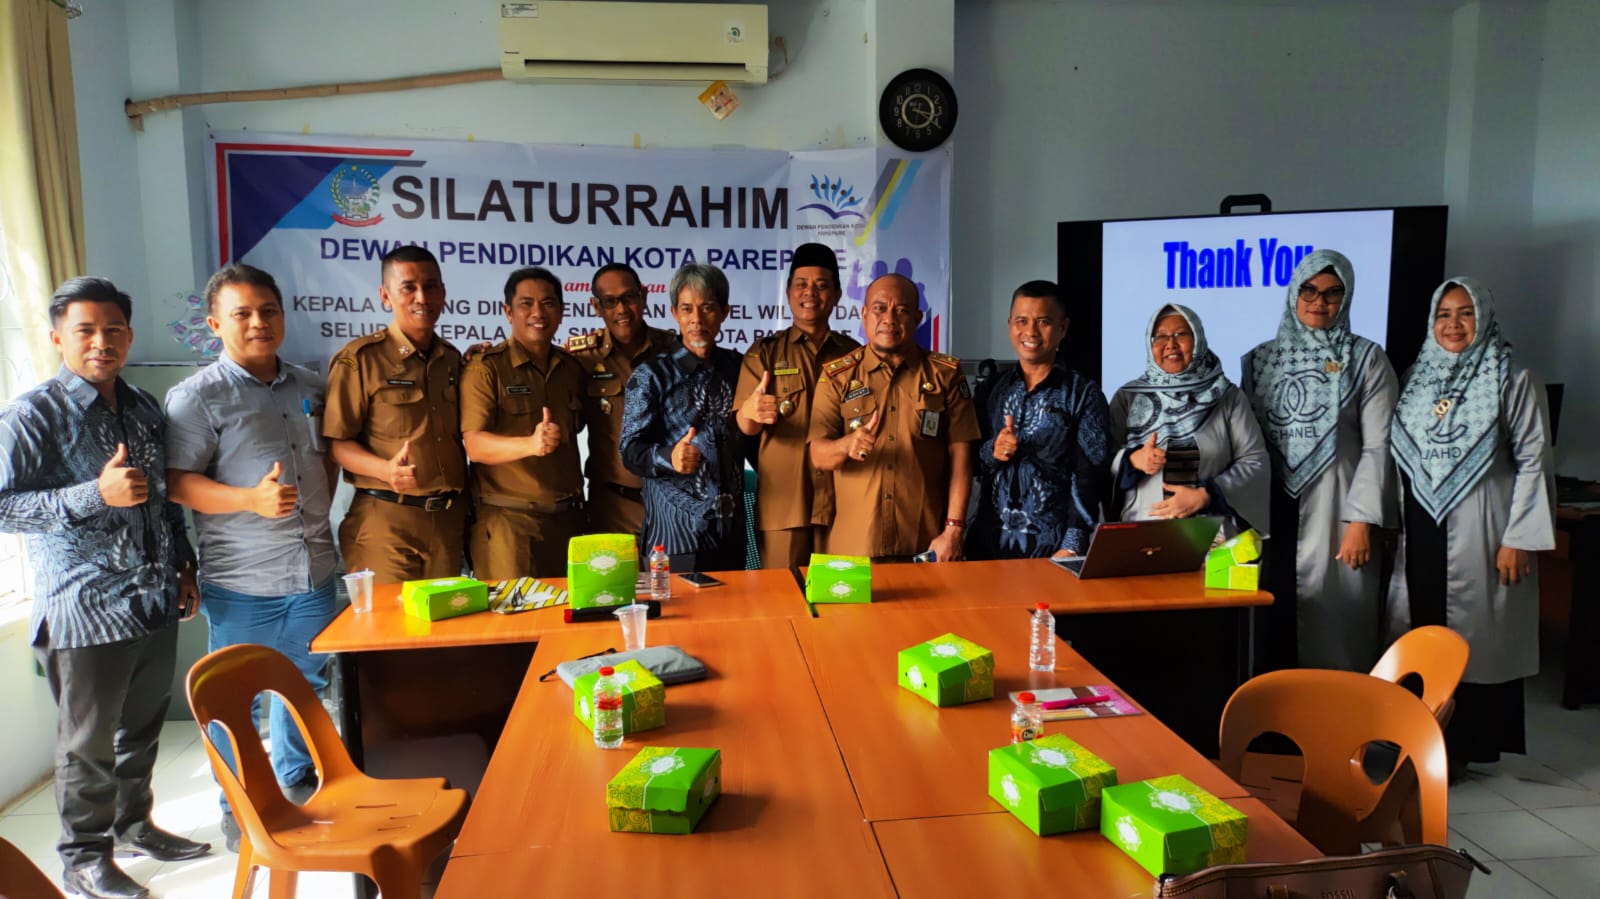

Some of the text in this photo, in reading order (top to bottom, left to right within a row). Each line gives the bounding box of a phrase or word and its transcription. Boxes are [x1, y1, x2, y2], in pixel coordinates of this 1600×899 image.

[391, 175, 789, 230] SILATURRAHIM
[439, 241, 615, 268] PENDIDIKAN
[624, 247, 698, 269] KOTA
[1163, 239, 1253, 289] Thank
[292, 296, 376, 313] KEPALA
[434, 324, 507, 341] EPALA
[1270, 426, 1321, 441] CHANEL
